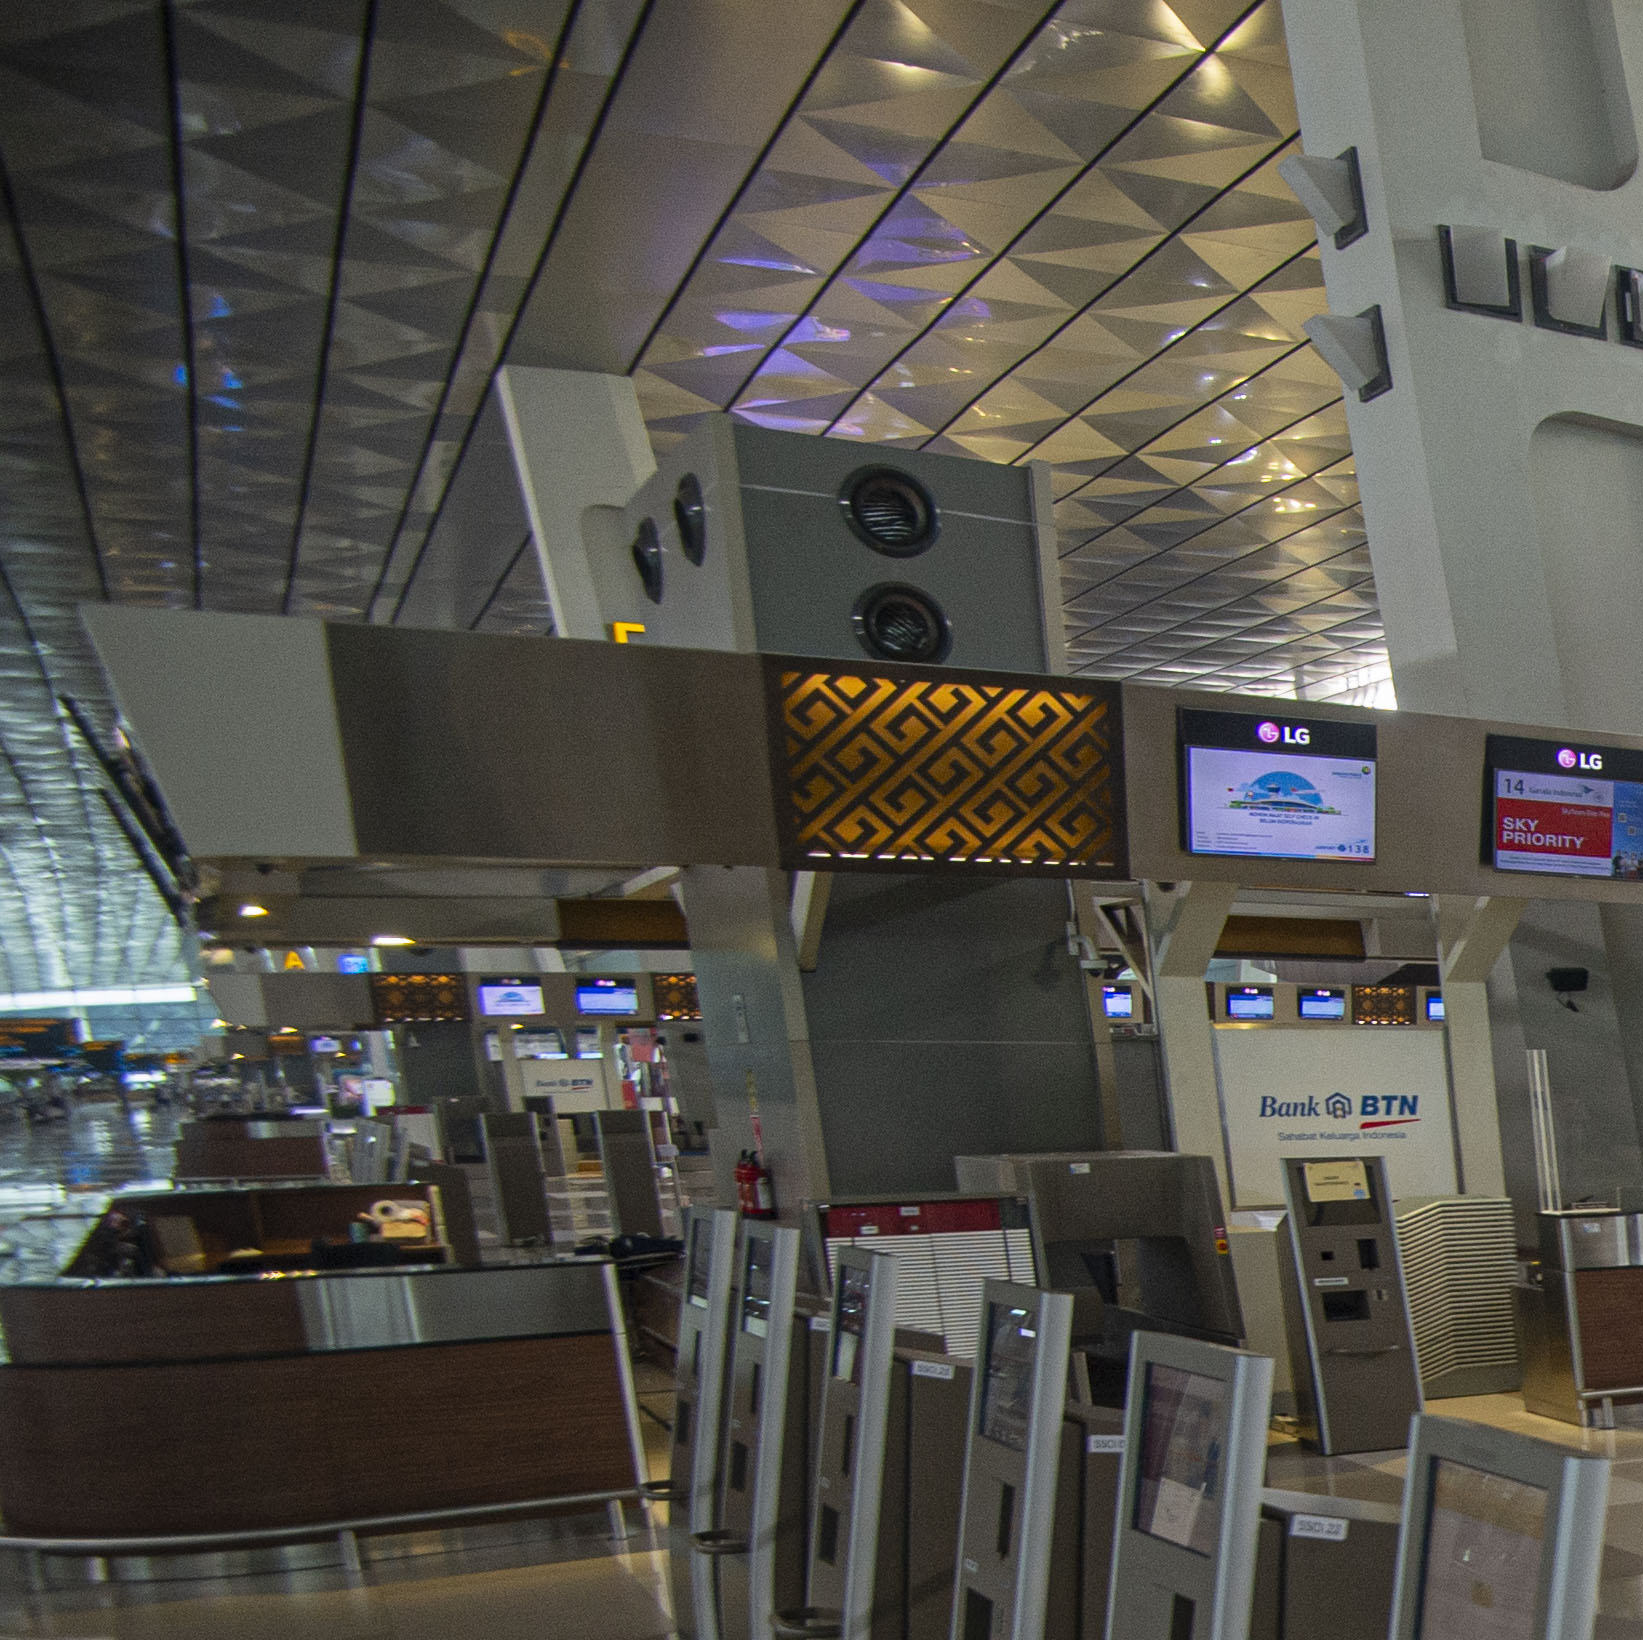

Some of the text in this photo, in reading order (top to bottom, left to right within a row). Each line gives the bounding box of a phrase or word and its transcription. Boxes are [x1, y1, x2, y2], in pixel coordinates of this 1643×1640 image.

[1282, 726, 1310, 745] LG
[1579, 752, 1603, 770] LG
[1504, 778, 1525, 795] 14
[1503, 817, 1538, 832] SKY
[1502, 831, 1585, 849] PRIORITY
[1259, 1095, 1419, 1118] Bank BTN
